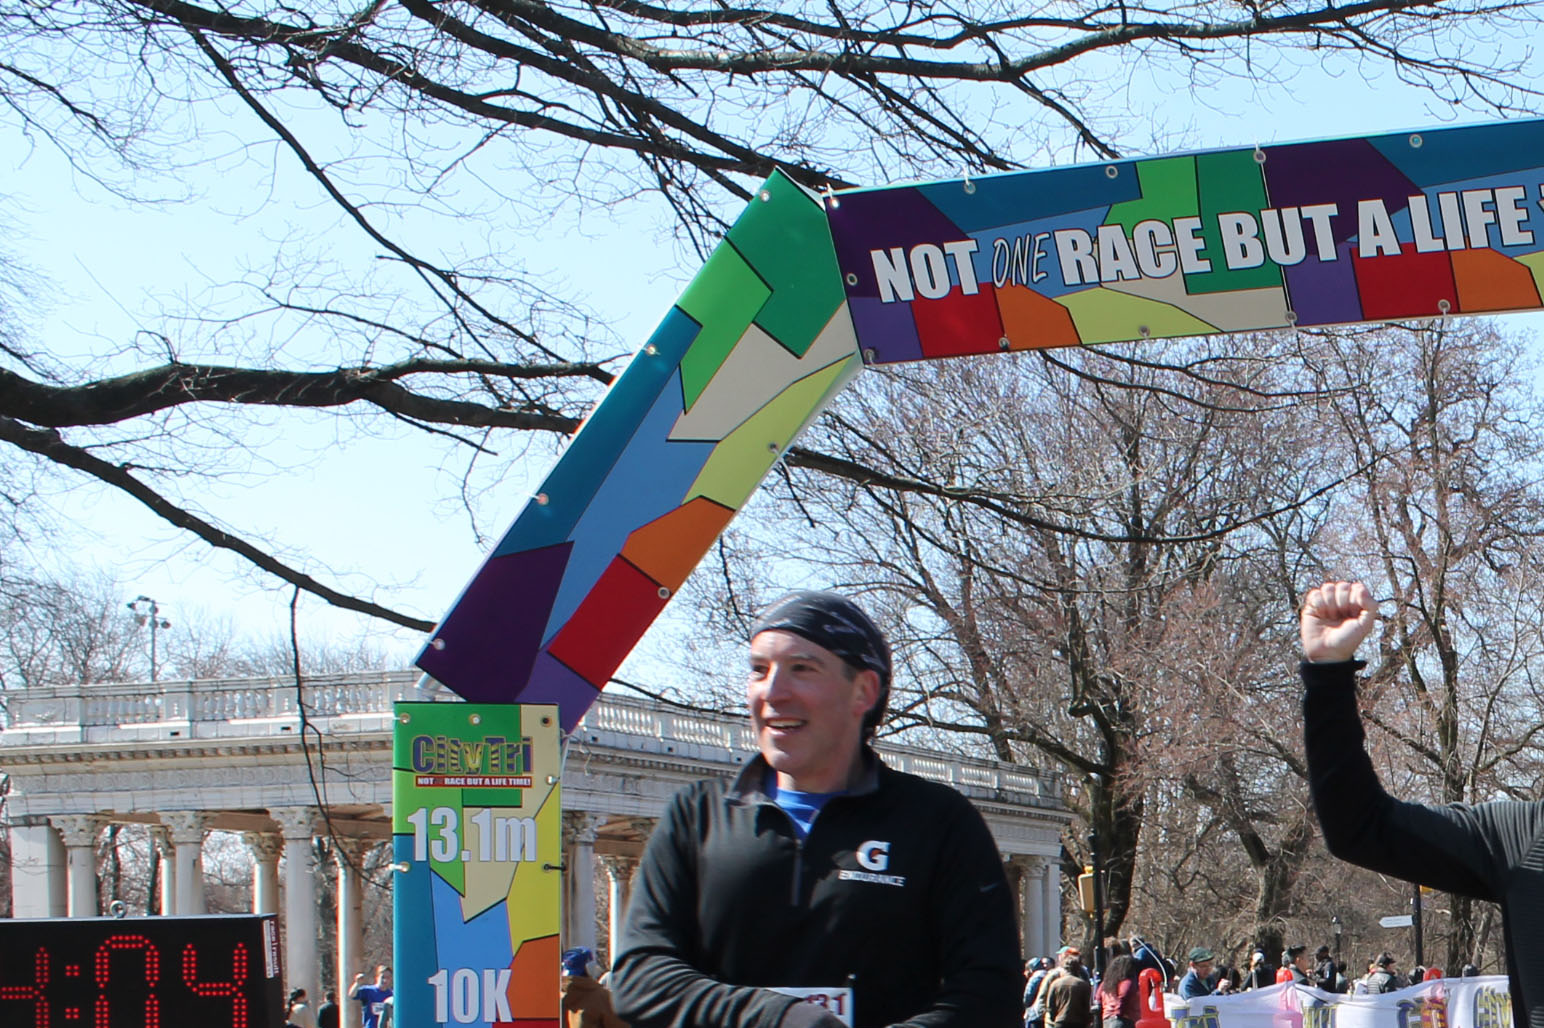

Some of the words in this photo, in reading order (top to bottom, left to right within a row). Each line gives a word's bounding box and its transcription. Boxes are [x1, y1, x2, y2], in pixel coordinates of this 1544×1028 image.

[870, 239, 979, 303] NOT
[992, 233, 1050, 289] ONE
[1053, 216, 1213, 286] RACE
[1217, 203, 1338, 270] BUT
[1357, 199, 1403, 258] A
[1407, 184, 1535, 254] LIFE
[411, 735, 534, 775] CityTri
[417, 777, 434, 785] NOT
[444, 777, 466, 785] RACE
[484, 777, 490, 785] A
[407, 805, 537, 863] 13.1m
[856, 840, 890, 872] G
[838, 870, 906, 887] ENDURANCE
[427, 967, 513, 1024] 10K
